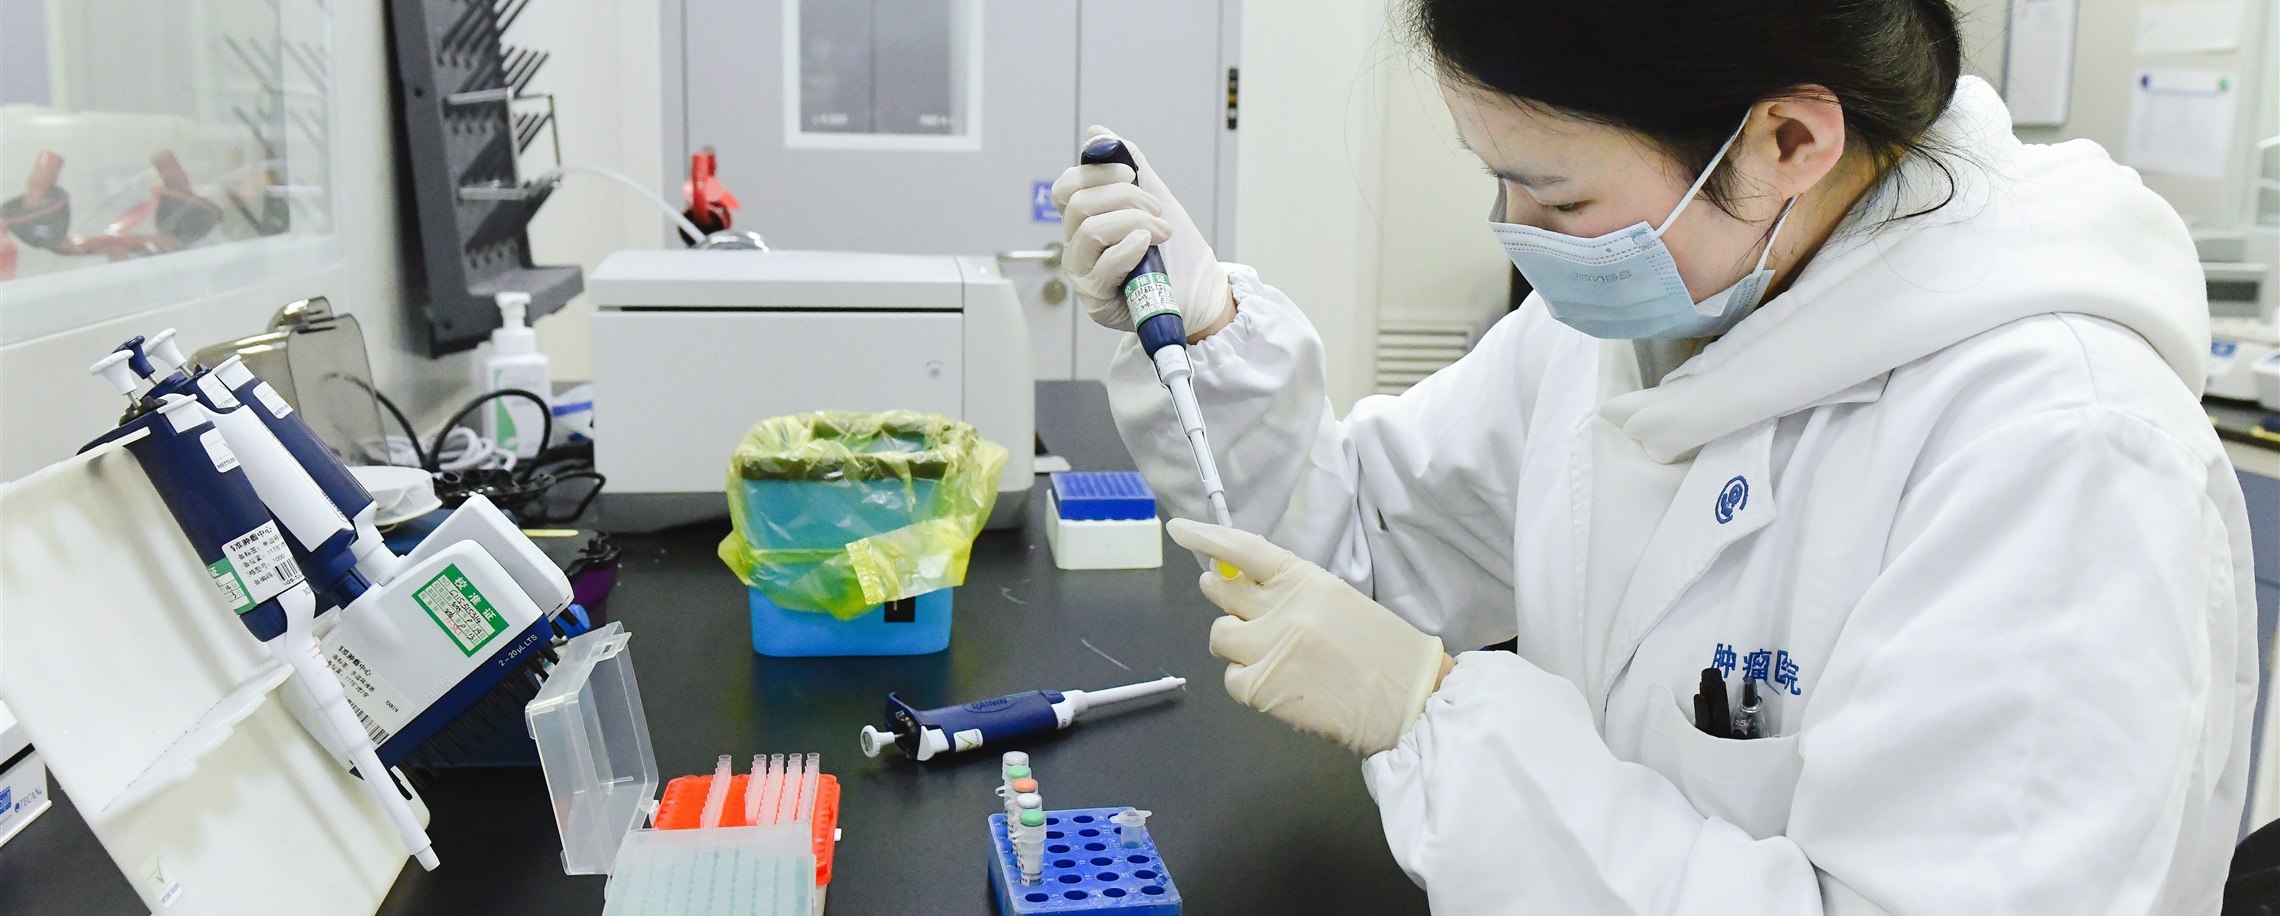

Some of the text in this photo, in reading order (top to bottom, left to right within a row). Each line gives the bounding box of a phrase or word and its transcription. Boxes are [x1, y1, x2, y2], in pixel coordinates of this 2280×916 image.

[217, 457, 236, 469] METTLER
[272, 553, 285, 563] 1000
[453, 576, 497, 622] 校准证
[524, 634, 538, 647] LTS
[1711, 643, 1801, 695] 肿瘤院
